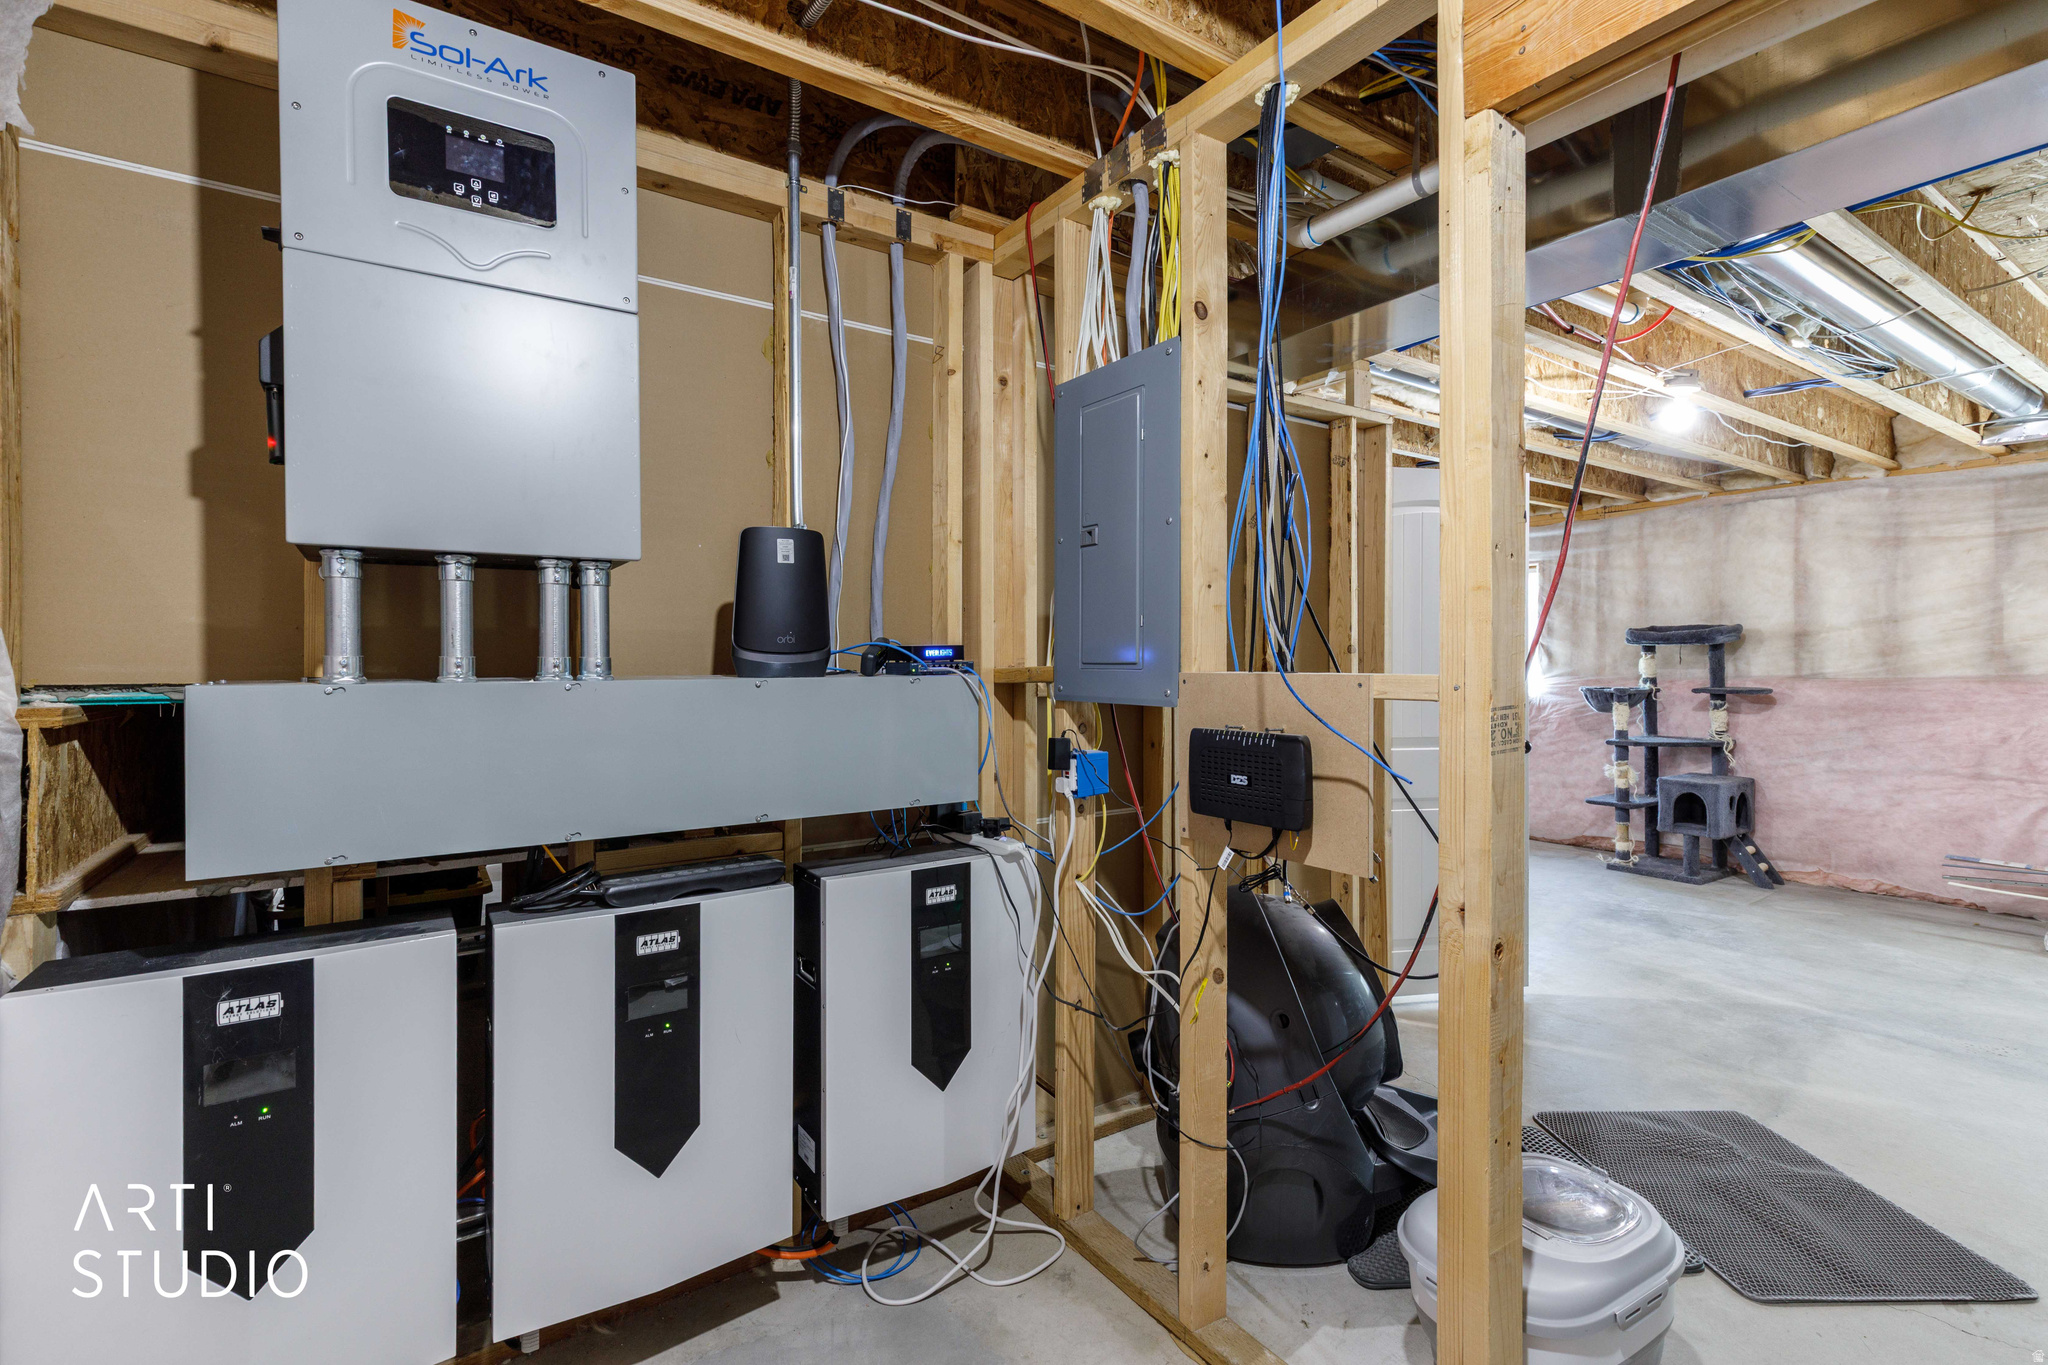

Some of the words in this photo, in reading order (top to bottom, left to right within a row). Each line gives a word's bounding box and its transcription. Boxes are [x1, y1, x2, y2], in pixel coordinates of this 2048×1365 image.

[410, 31, 548, 93] Sol-Ark
[410, 54, 493, 83] LIMITLESS
[502, 81, 550, 100] POWER
[732, 85, 783, 117] APA
[777, 635, 796, 644] orbi
[925, 649, 953, 657] EVERLIGHTS
[1230, 774, 1248, 786] DZS
[928, 889, 954, 898] ATLAS
[640, 936, 676, 948] ATLAS
[223, 1000, 277, 1016] ATLAS
